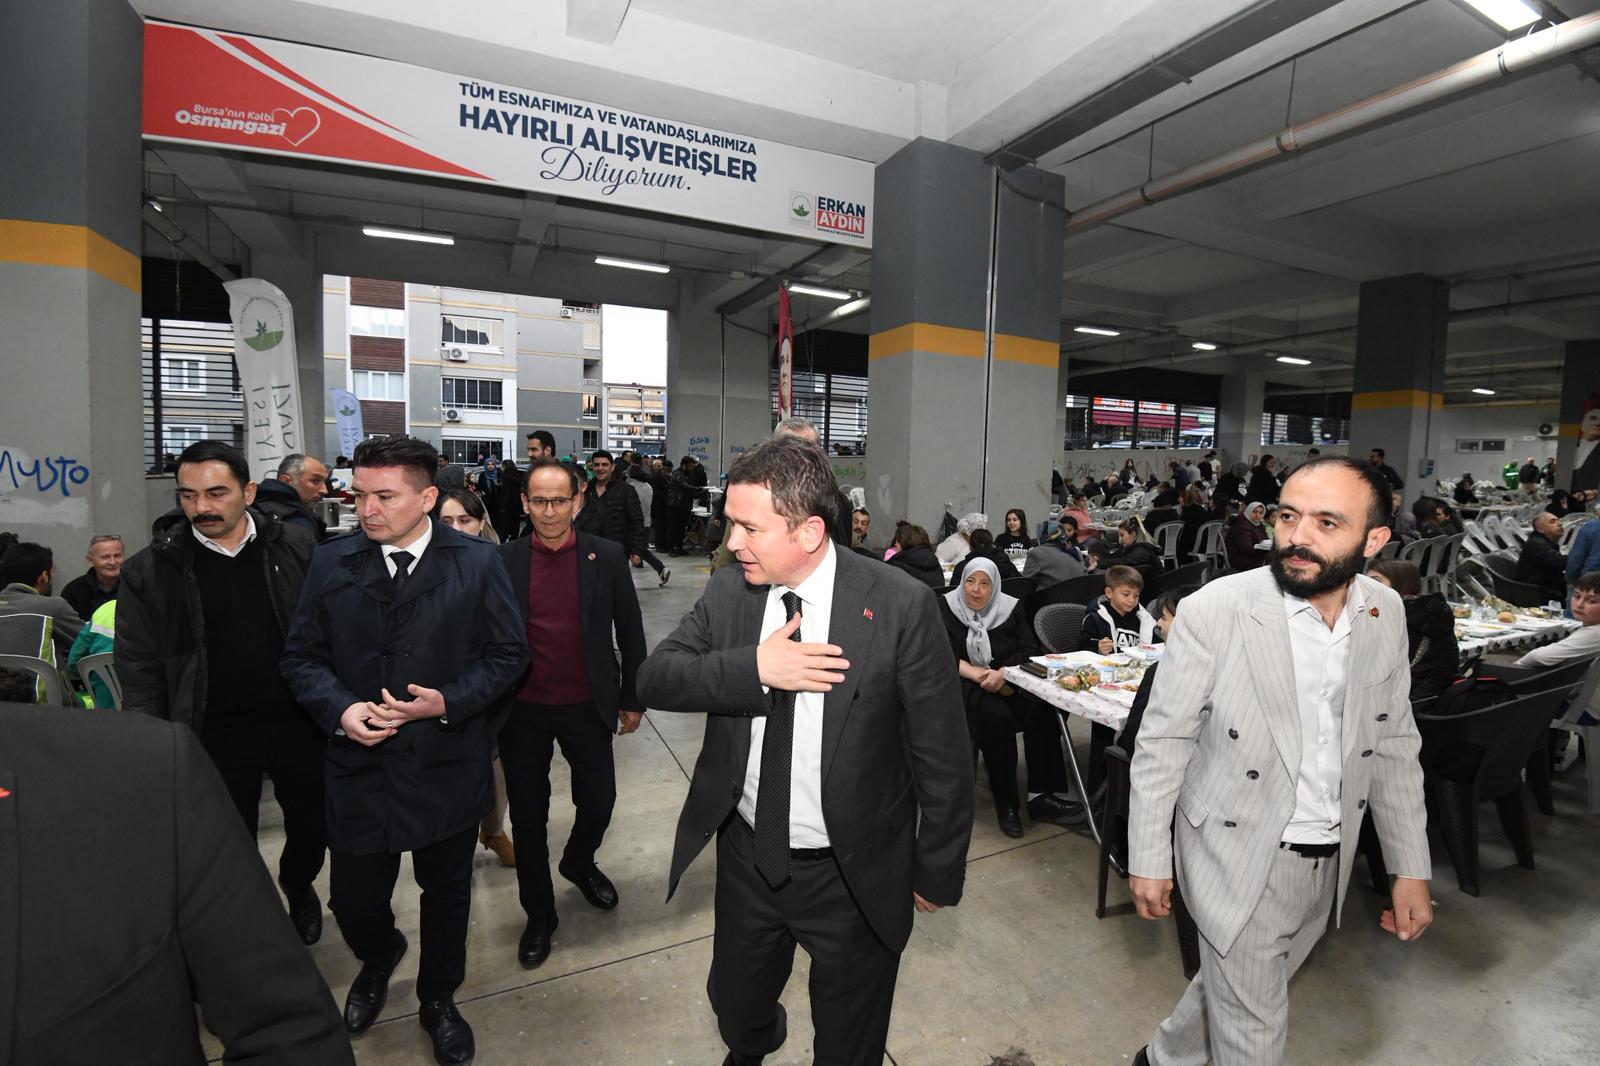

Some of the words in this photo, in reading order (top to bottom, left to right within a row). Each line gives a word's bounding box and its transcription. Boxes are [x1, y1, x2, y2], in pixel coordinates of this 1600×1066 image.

[175, 109, 287, 135] Osmangazi
[193, 104, 245, 118] Bursa'nın
[247, 111, 275, 122] Kalbi
[459, 82, 494, 101] TÜM
[499, 90, 594, 120] ESNAFIMIZA
[598, 109, 617, 125] VE
[620, 114, 757, 156] VATANDAŞLARIMIZA
[459, 103, 573, 146] HAYIRLI
[580, 127, 757, 182] ALIŞVERİŞLER
[540, 146, 691, 195] Diliyorum.
[817, 196, 866, 218] ERKAN
[819, 211, 863, 232] AYDIN
[1117, 633, 1140, 648] AN
